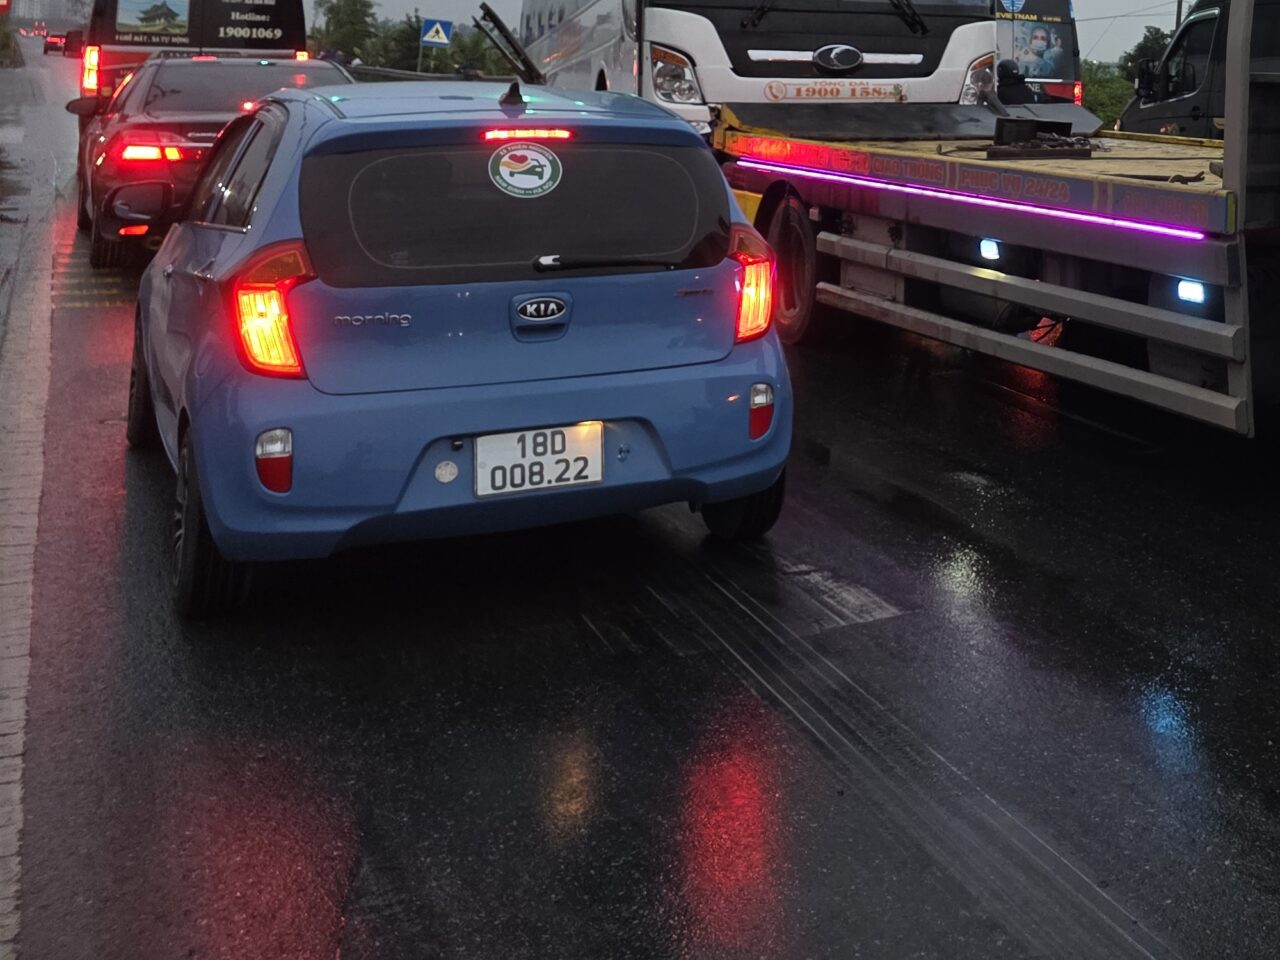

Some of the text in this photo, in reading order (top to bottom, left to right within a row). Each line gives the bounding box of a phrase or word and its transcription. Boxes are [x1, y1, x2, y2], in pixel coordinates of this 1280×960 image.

[231, 11, 270, 22] Hotline:
[218, 26, 283, 39] 19001069
[795, 87, 840, 98] 1900
[958, 166, 999, 191] PHỤC
[1024, 176, 1071, 202] 24/24
[525, 301, 558, 317] KIA
[334, 311, 412, 327] morning
[516, 429, 566, 459] 18D
[490, 456, 590, 492] 008.22
